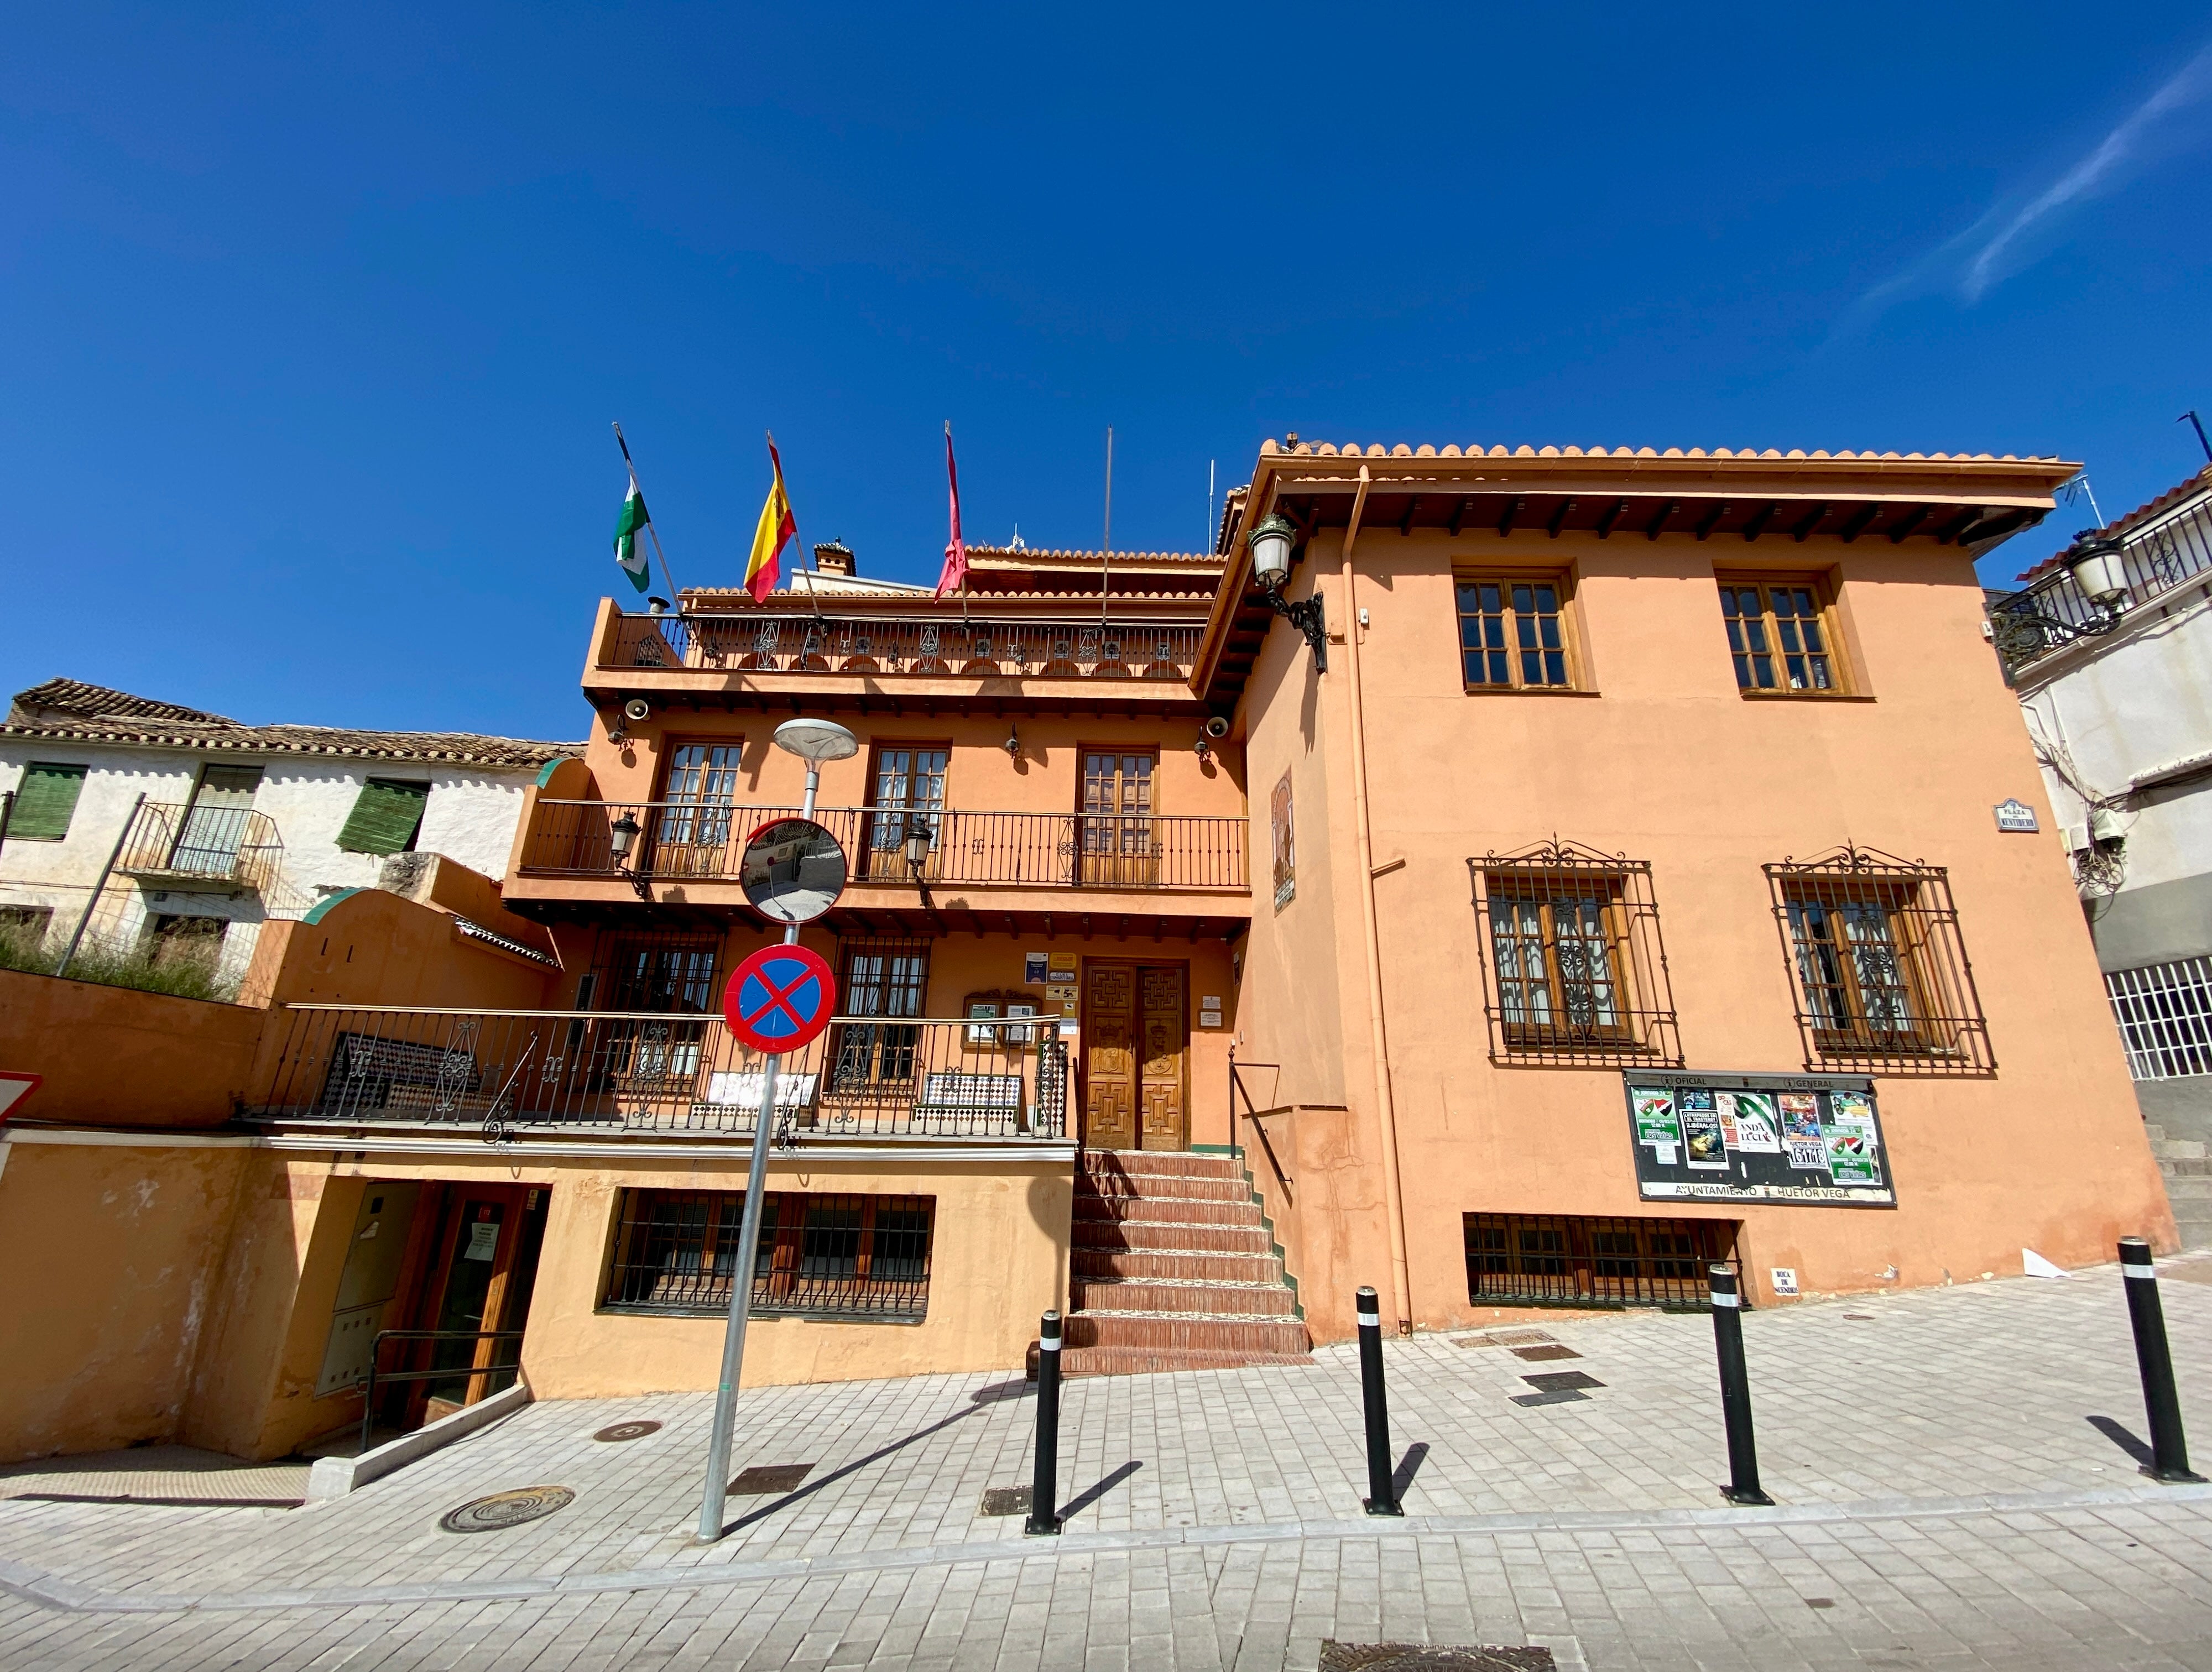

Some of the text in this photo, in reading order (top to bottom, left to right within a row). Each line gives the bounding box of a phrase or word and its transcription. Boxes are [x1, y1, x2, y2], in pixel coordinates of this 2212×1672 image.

[1740, 1122, 1765, 1132] ANDA
[1778, 1188, 1819, 1198] HUETOR
[1822, 1189, 1851, 1198] VEGA
